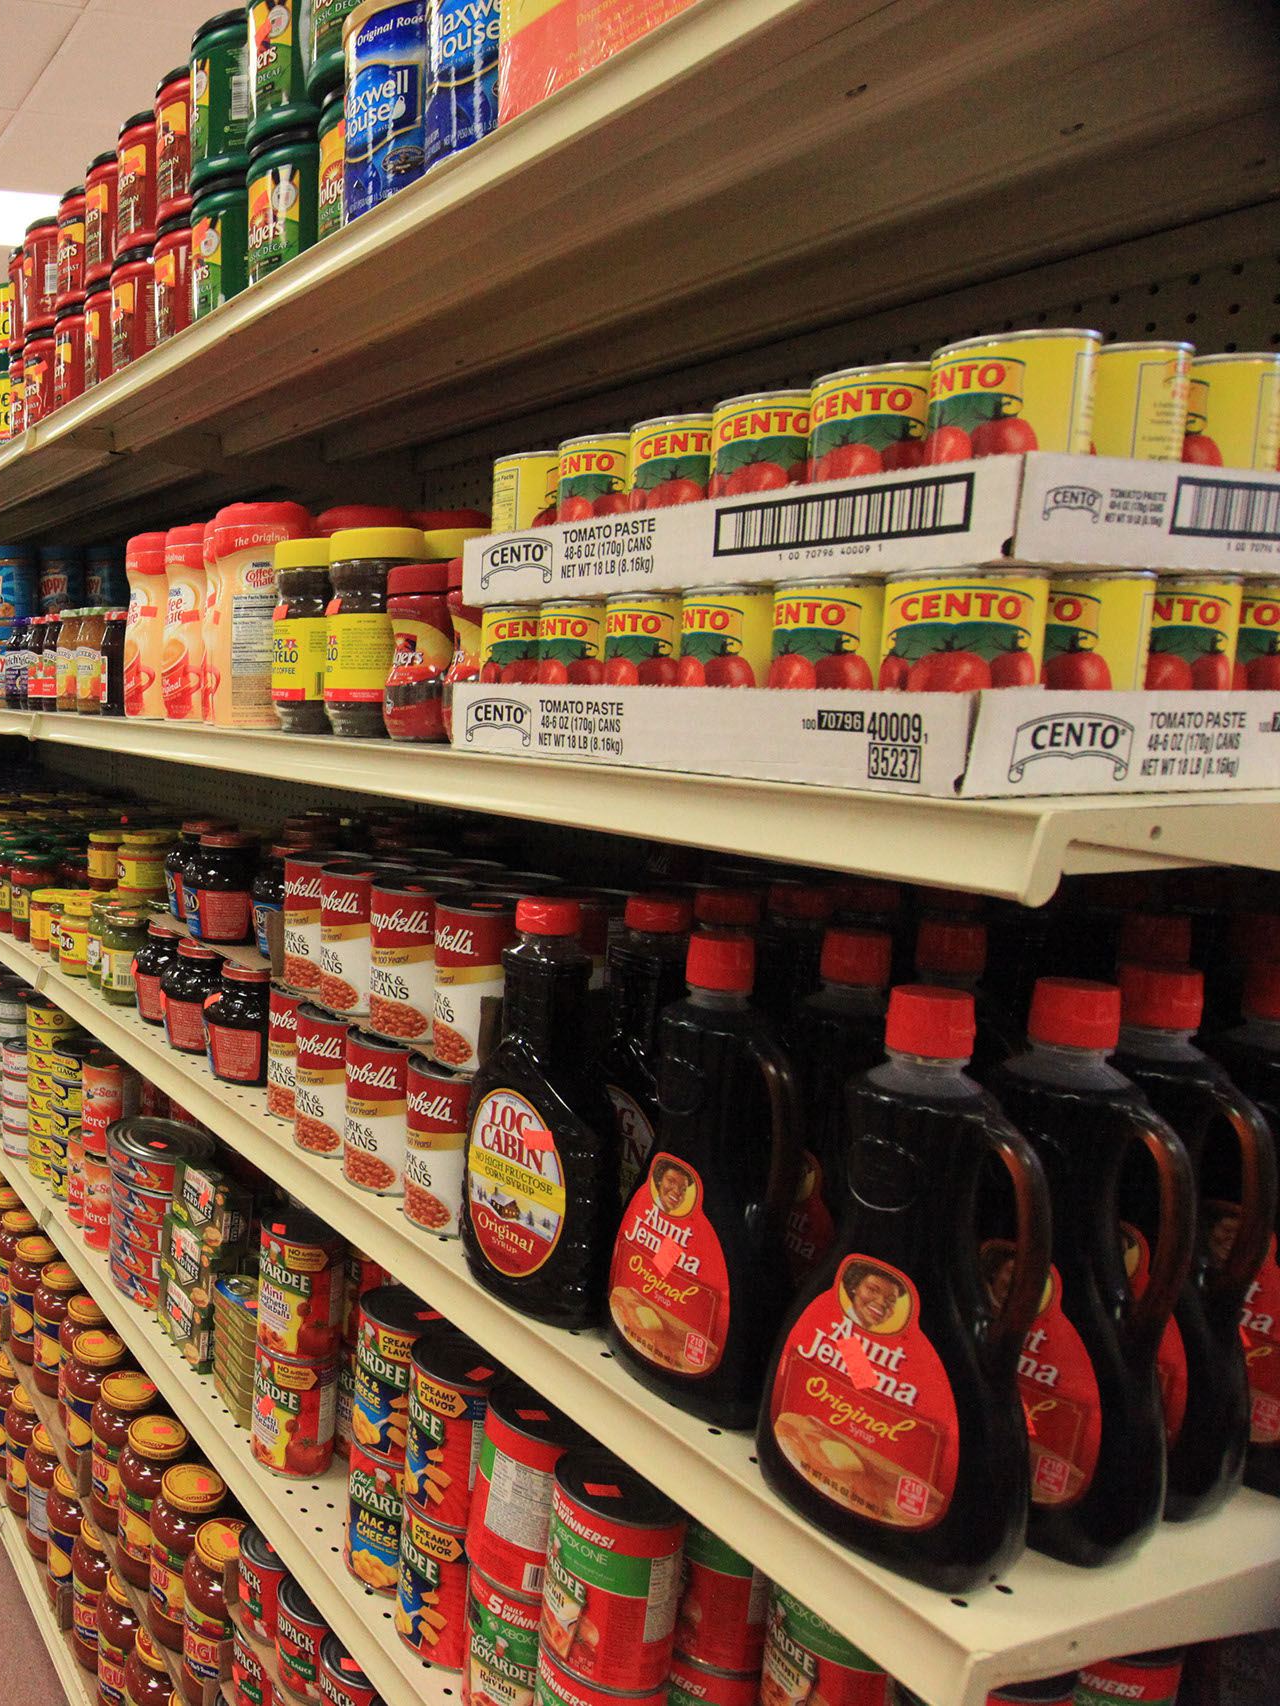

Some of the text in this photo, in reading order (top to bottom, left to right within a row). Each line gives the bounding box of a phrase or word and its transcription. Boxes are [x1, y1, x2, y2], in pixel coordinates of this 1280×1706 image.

[357, 19, 395, 46] Original
[257, 68, 282, 85] DECAF
[263, 241, 289, 255] DECAF
[930, 362, 1007, 399] ENTO
[812, 387, 913, 423] CENTO
[720, 411, 810, 442] CENTO
[558, 451, 616, 475] ENTO
[1052, 490, 1097, 509] CENTO
[562, 518, 657, 545] TOMATO PASTE
[234, 537, 250, 547] The
[564, 536, 652, 560] 48-6 OZ (170g) CANS
[788, 544, 871, 560] 00 70796 40009
[490, 544, 544, 566] CENTO
[561, 554, 654, 580] NET WT 18 LB (8.16kg)
[253, 576, 275, 588] mate
[773, 602, 846, 627] ENTO
[900, 593, 1022, 622] CENTO
[606, 614, 662, 634] ENTO
[276, 667, 296, 675] COFFEE
[474, 704, 524, 724] CENTO
[539, 699, 624, 716] TOMATO PASTE
[541, 715, 621, 735] 48-6 OZ (170g) CANS
[802, 711, 928, 744] 100 70796 40009 1
[1150, 712, 1247, 729] TOMATO PASTE
[538, 733, 624, 756] NET WT 18 LB (8.16kg)
[1031, 722, 1121, 750] CENTO
[1171, 733, 1184, 750] OZ
[1216, 732, 1241, 750] CANS
[871, 746, 919, 779] 35237
[1140, 757, 1160, 776] NET
[1161, 757, 1176, 775] WT
[1190, 757, 1202, 775] LB
[370, 908, 431, 934] ampbell's
[297, 934, 306, 944] &
[331, 951, 339, 962] &
[388, 955, 409, 964] Years!
[394, 975, 405, 986] &
[56, 1066, 78, 1079] CLAMS
[284, 1064, 293, 1075] &
[99, 1087, 118, 1098] Sea
[312, 1095, 320, 1105] &
[358, 1107, 378, 1117] Years!
[363, 1128, 373, 1139] &
[419, 1160, 428, 1173] &
[475, 1150, 554, 1197] NO HIGH FRUCTOSE
[485, 1165, 535, 1198] CORN SYRUP
[478, 1211, 535, 1255] Original
[645, 1204, 693, 1249] Aunt
[288, 1248, 300, 1256] NO
[491, 1236, 518, 1256] SYRUP
[629, 1253, 700, 1306] Original
[263, 1279, 284, 1301] Mini
[688, 1335, 705, 1348] 210
[277, 1364, 288, 1374] NO
[372, 1381, 380, 1393] &
[420, 1381, 457, 1403] CREAMY
[420, 1391, 456, 1413] FLAVOR
[806, 1376, 917, 1442] Original
[848, 1421, 876, 1445] Syrup
[1041, 1456, 1064, 1474] 210
[353, 1470, 371, 1488] Chef
[903, 1478, 924, 1494] 210
[349, 1474, 403, 1517] BOYARD
[359, 1509, 397, 1536] MAC &
[556, 1507, 616, 1549] WINNERS!
[356, 1522, 398, 1550] CHEESE
[415, 1524, 453, 1547] CREAMY
[415, 1533, 452, 1557] FLAVOR
[581, 1546, 609, 1566] ONE
[487, 1593, 504, 1615] 5
[503, 1604, 524, 1616] DAILY
[476, 1634, 493, 1649] Chef
[500, 1625, 531, 1645] XBOX
[291, 1660, 313, 1676] SAUCE
[471, 1636, 536, 1688] BOYARDEE
[241, 1683, 260, 1700] SAUCE
[480, 1668, 517, 1699] Ravioli
